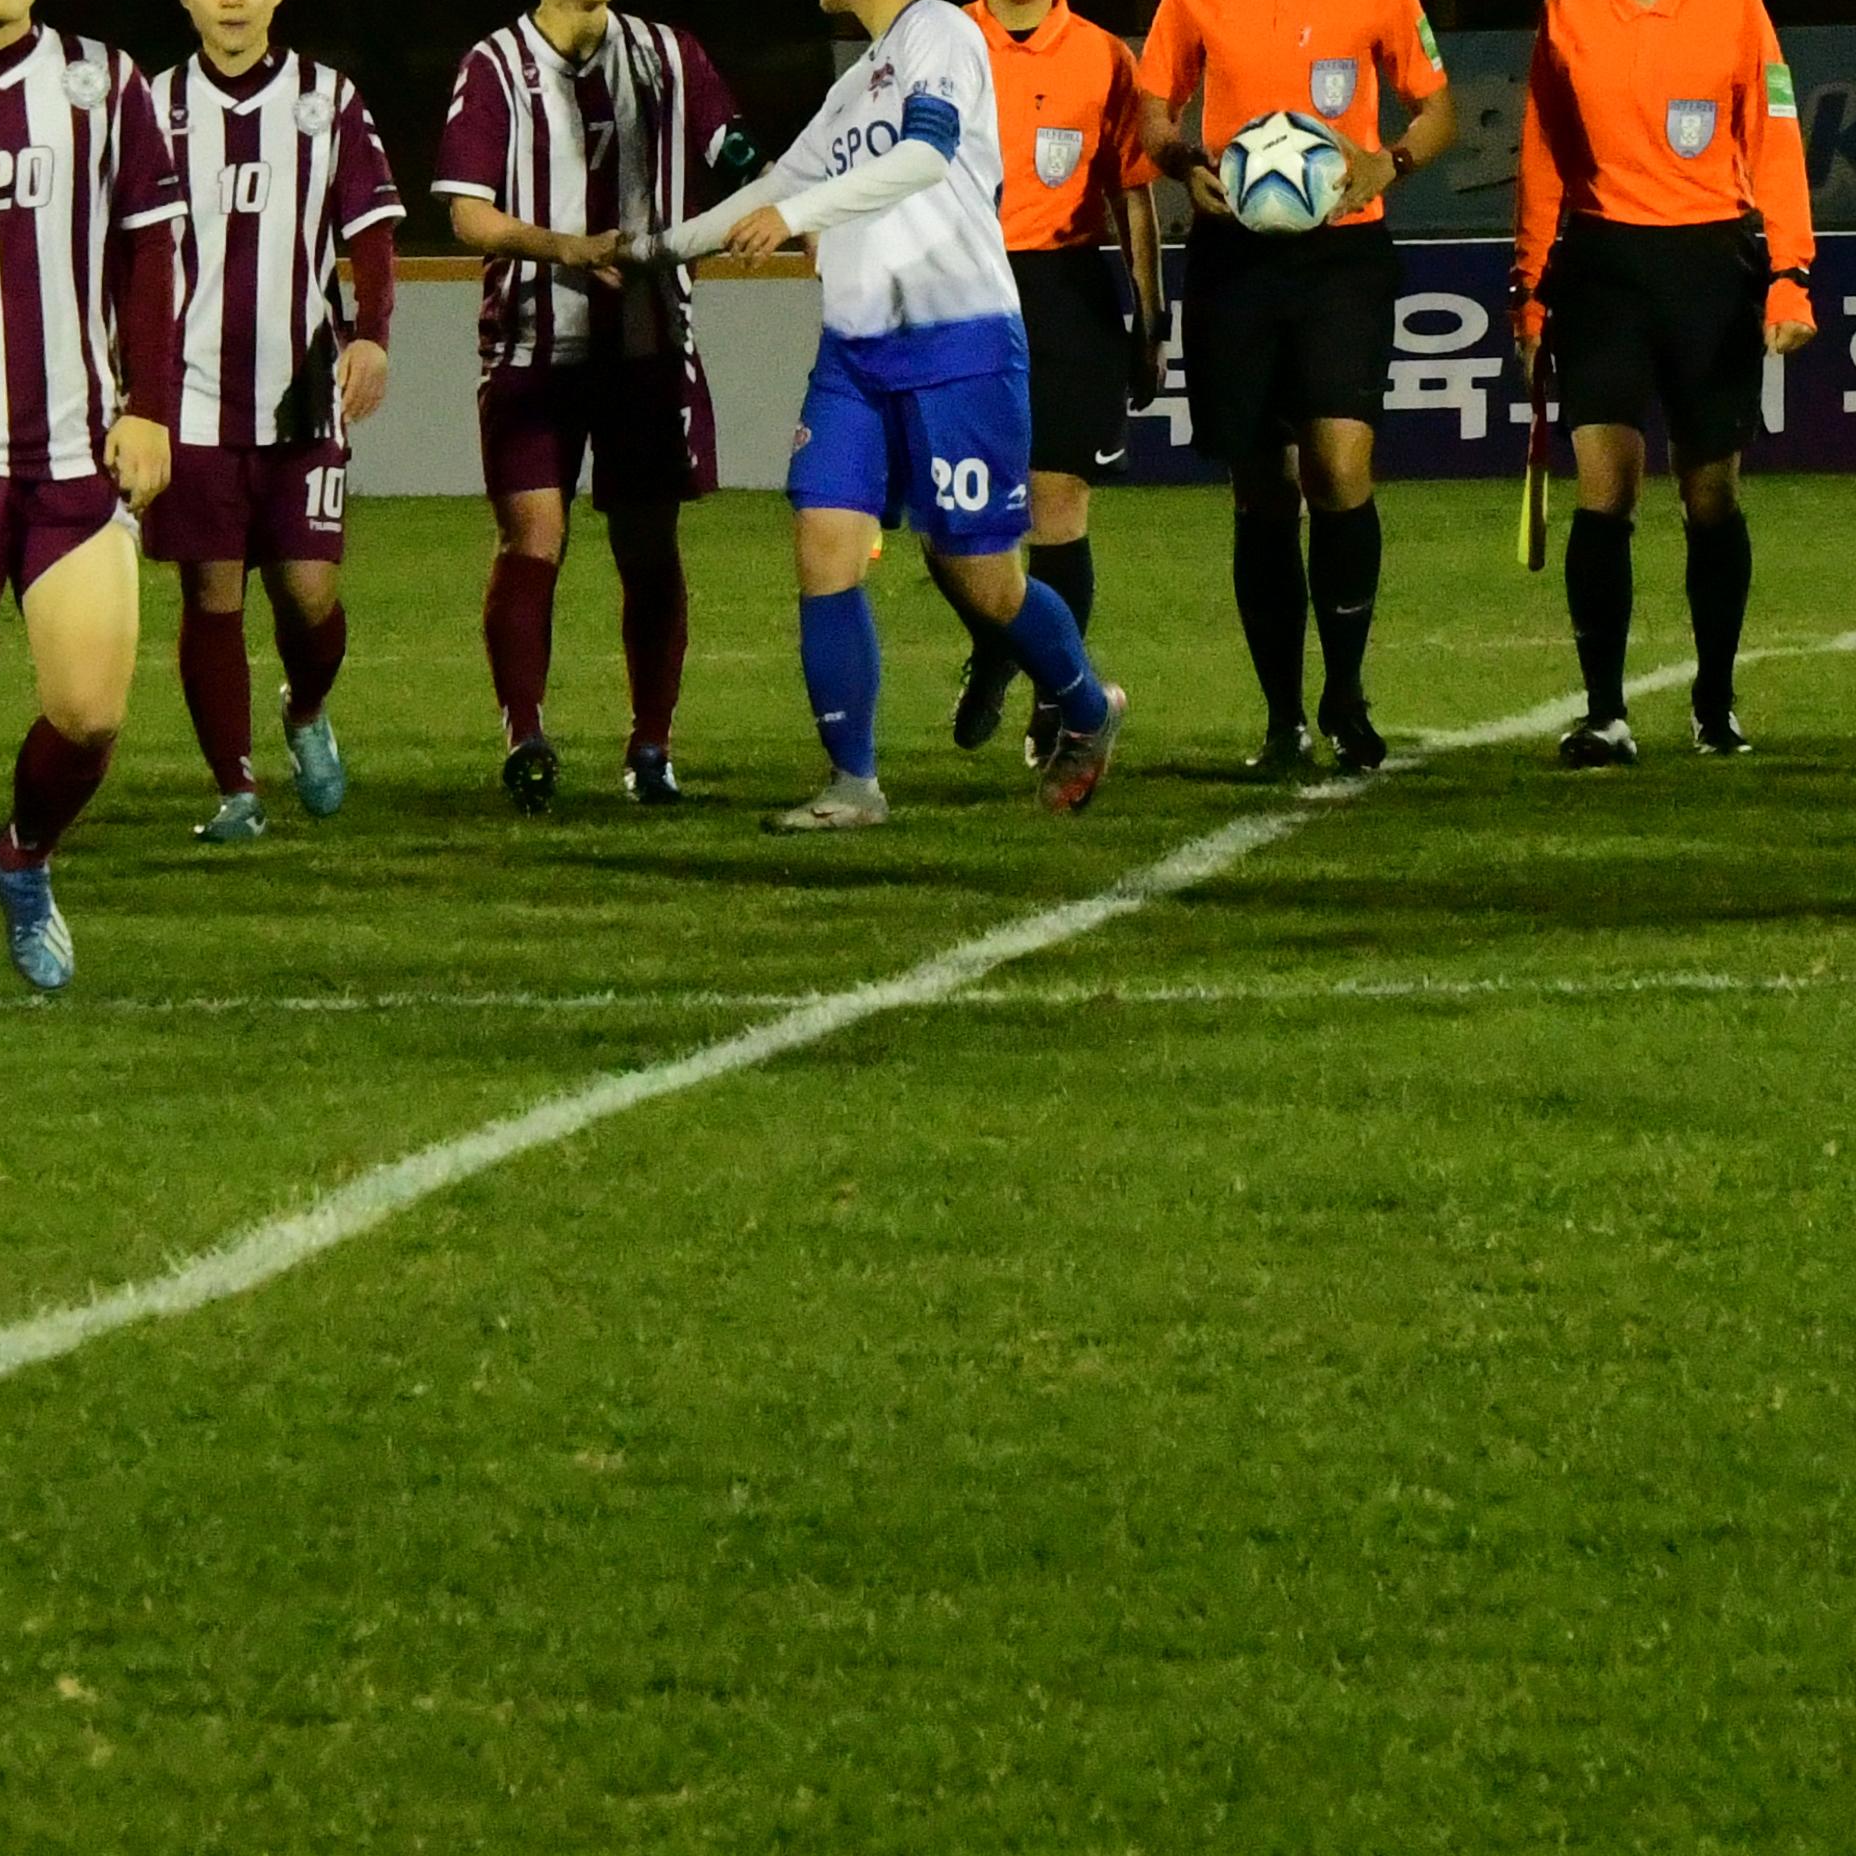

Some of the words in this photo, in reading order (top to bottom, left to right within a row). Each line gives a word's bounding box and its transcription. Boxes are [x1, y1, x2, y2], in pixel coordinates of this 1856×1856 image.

[588, 119, 616, 171] 7
[217, 161, 273, 216] 10
[304, 465, 346, 519] 10
[931, 456, 990, 512] 20
